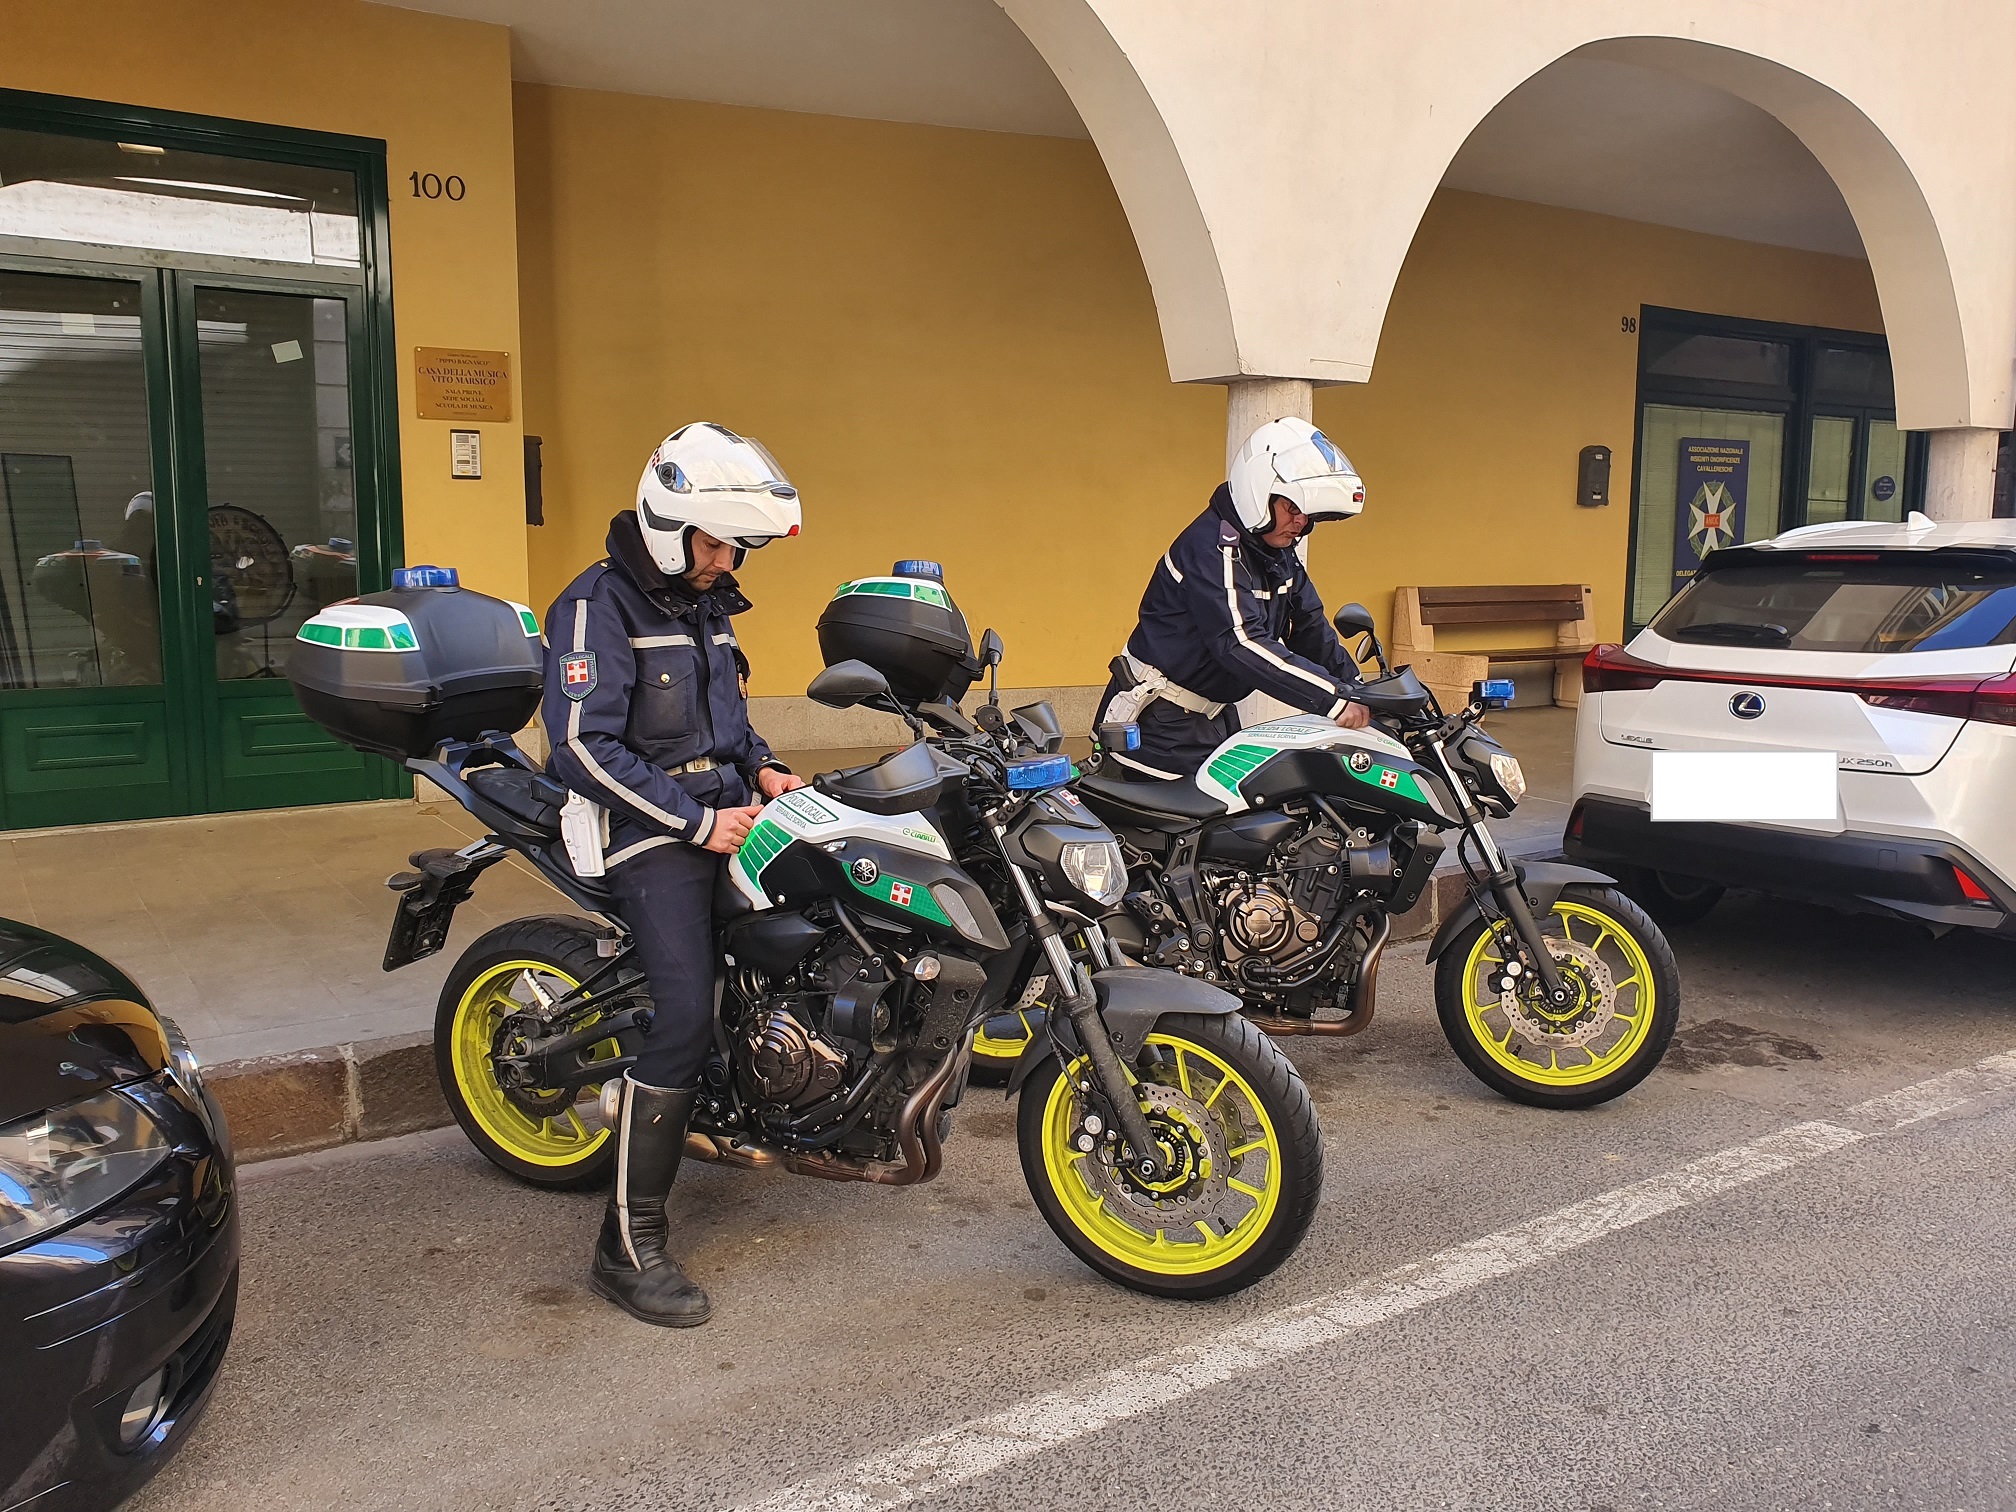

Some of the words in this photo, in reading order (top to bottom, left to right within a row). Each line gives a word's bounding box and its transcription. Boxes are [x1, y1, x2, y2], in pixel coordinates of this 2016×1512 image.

[409, 171, 466, 202] 100
[1621, 316, 1637, 333] 98
[443, 368, 472, 376] DELLA
[474, 370, 508, 378] MUSICA
[456, 377, 496, 386] MARSICO
[1856, 758, 1893, 768] 250h
[802, 803, 827, 822] LOCALE
